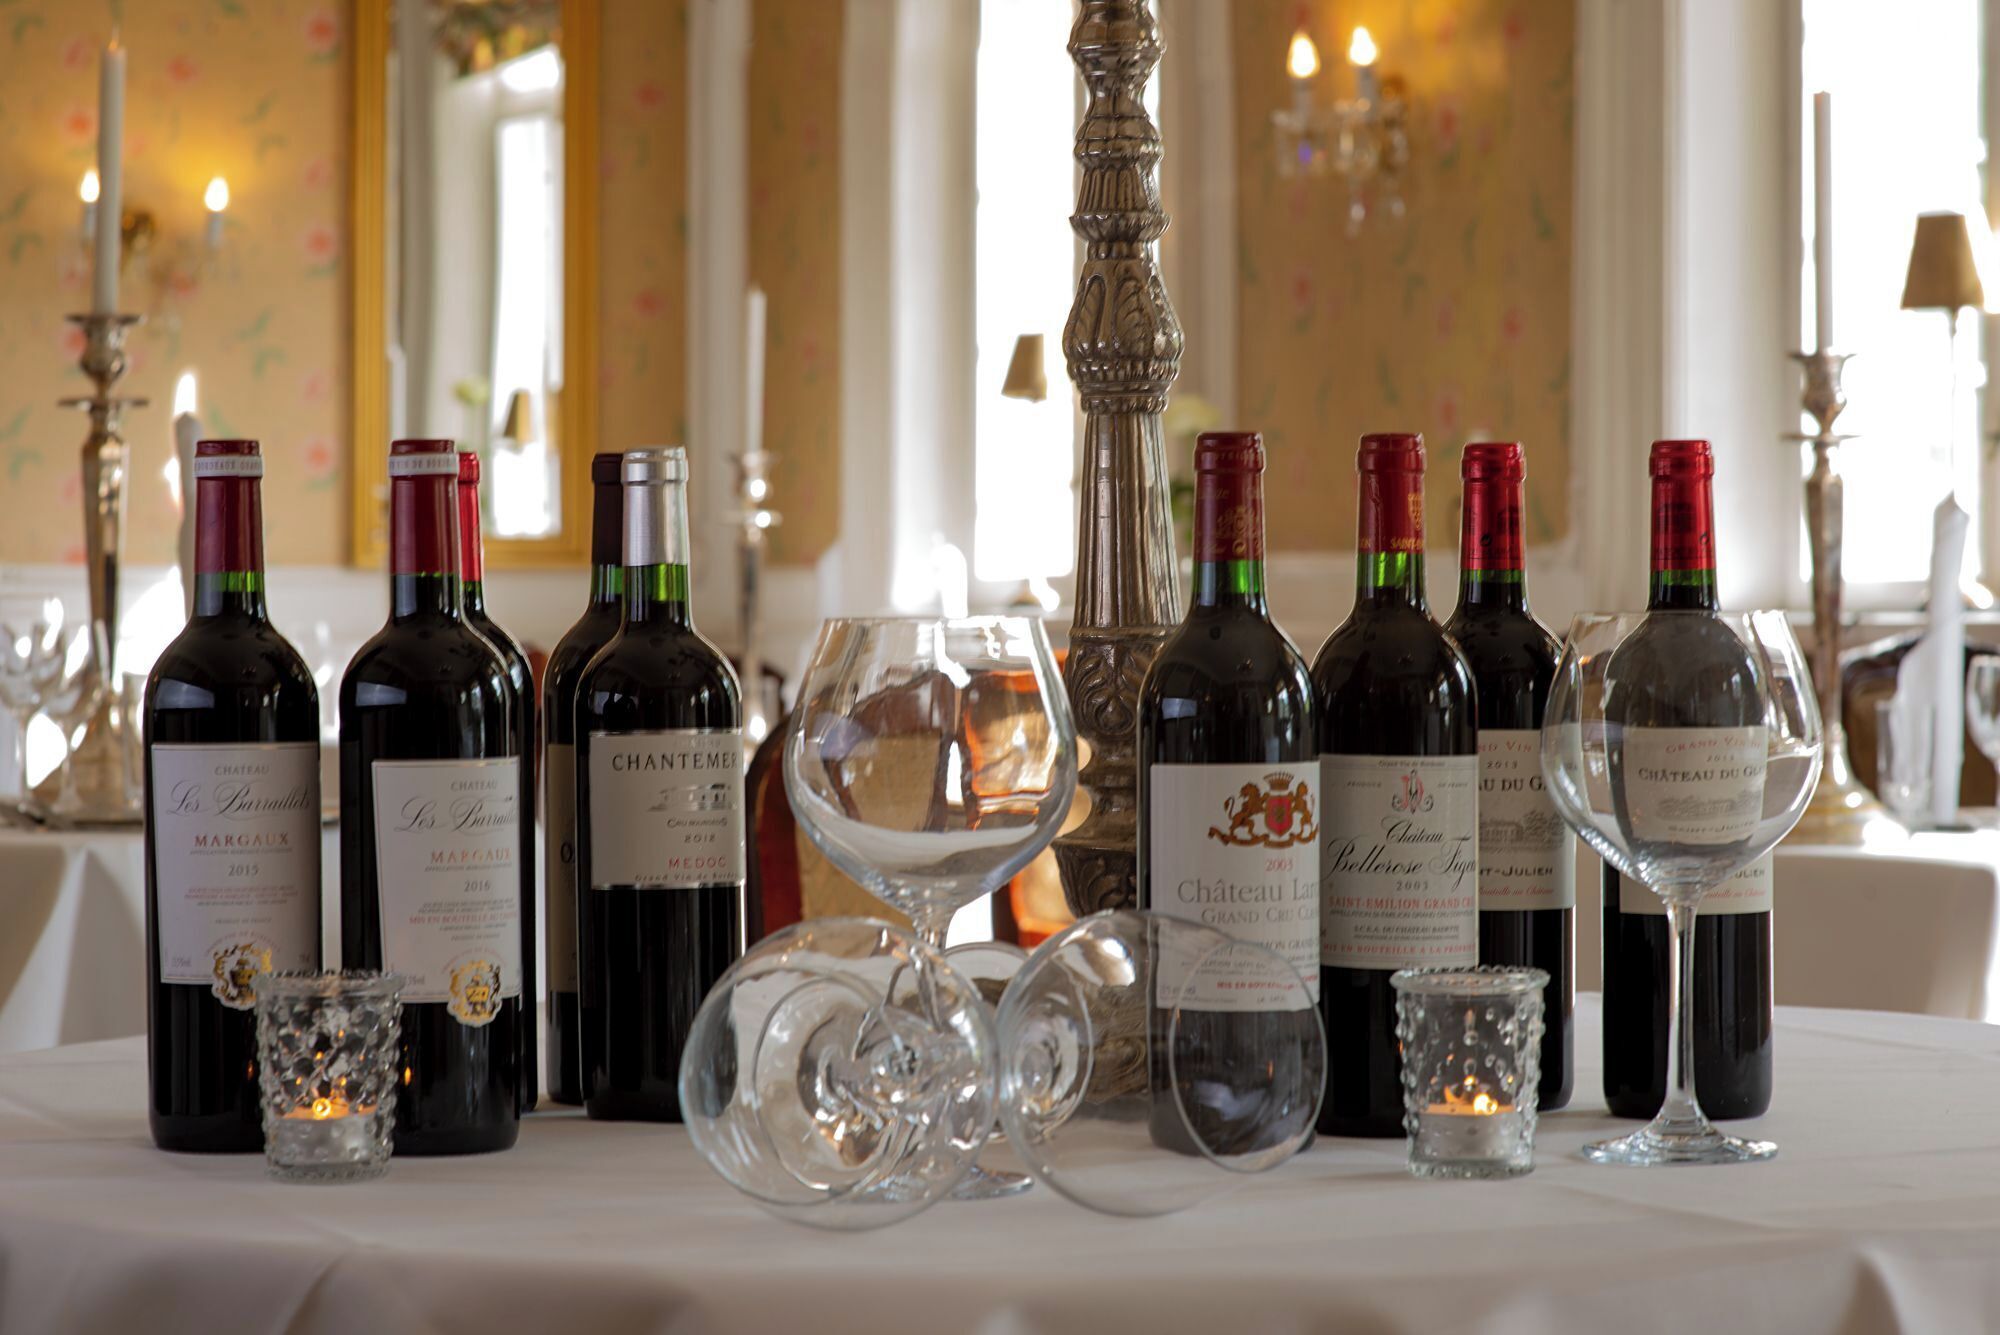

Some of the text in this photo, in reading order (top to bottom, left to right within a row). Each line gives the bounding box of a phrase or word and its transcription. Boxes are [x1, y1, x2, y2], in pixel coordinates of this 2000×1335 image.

[1506, 741, 1532, 753] VIN
[1719, 769, 1740, 781] DU
[1501, 778, 1523, 792] DU
[166, 780, 210, 818] Les
[393, 796, 448, 834] Les
[193, 832, 290, 848] MARGAUX
[1321, 834, 1423, 882] Bellerose
[227, 864, 259, 877] 2015
[464, 880, 491, 893] 2016
[1176, 877, 1283, 904] Château
[1200, 907, 1259, 925] GRAND
[1266, 906, 1294, 923] CRU
